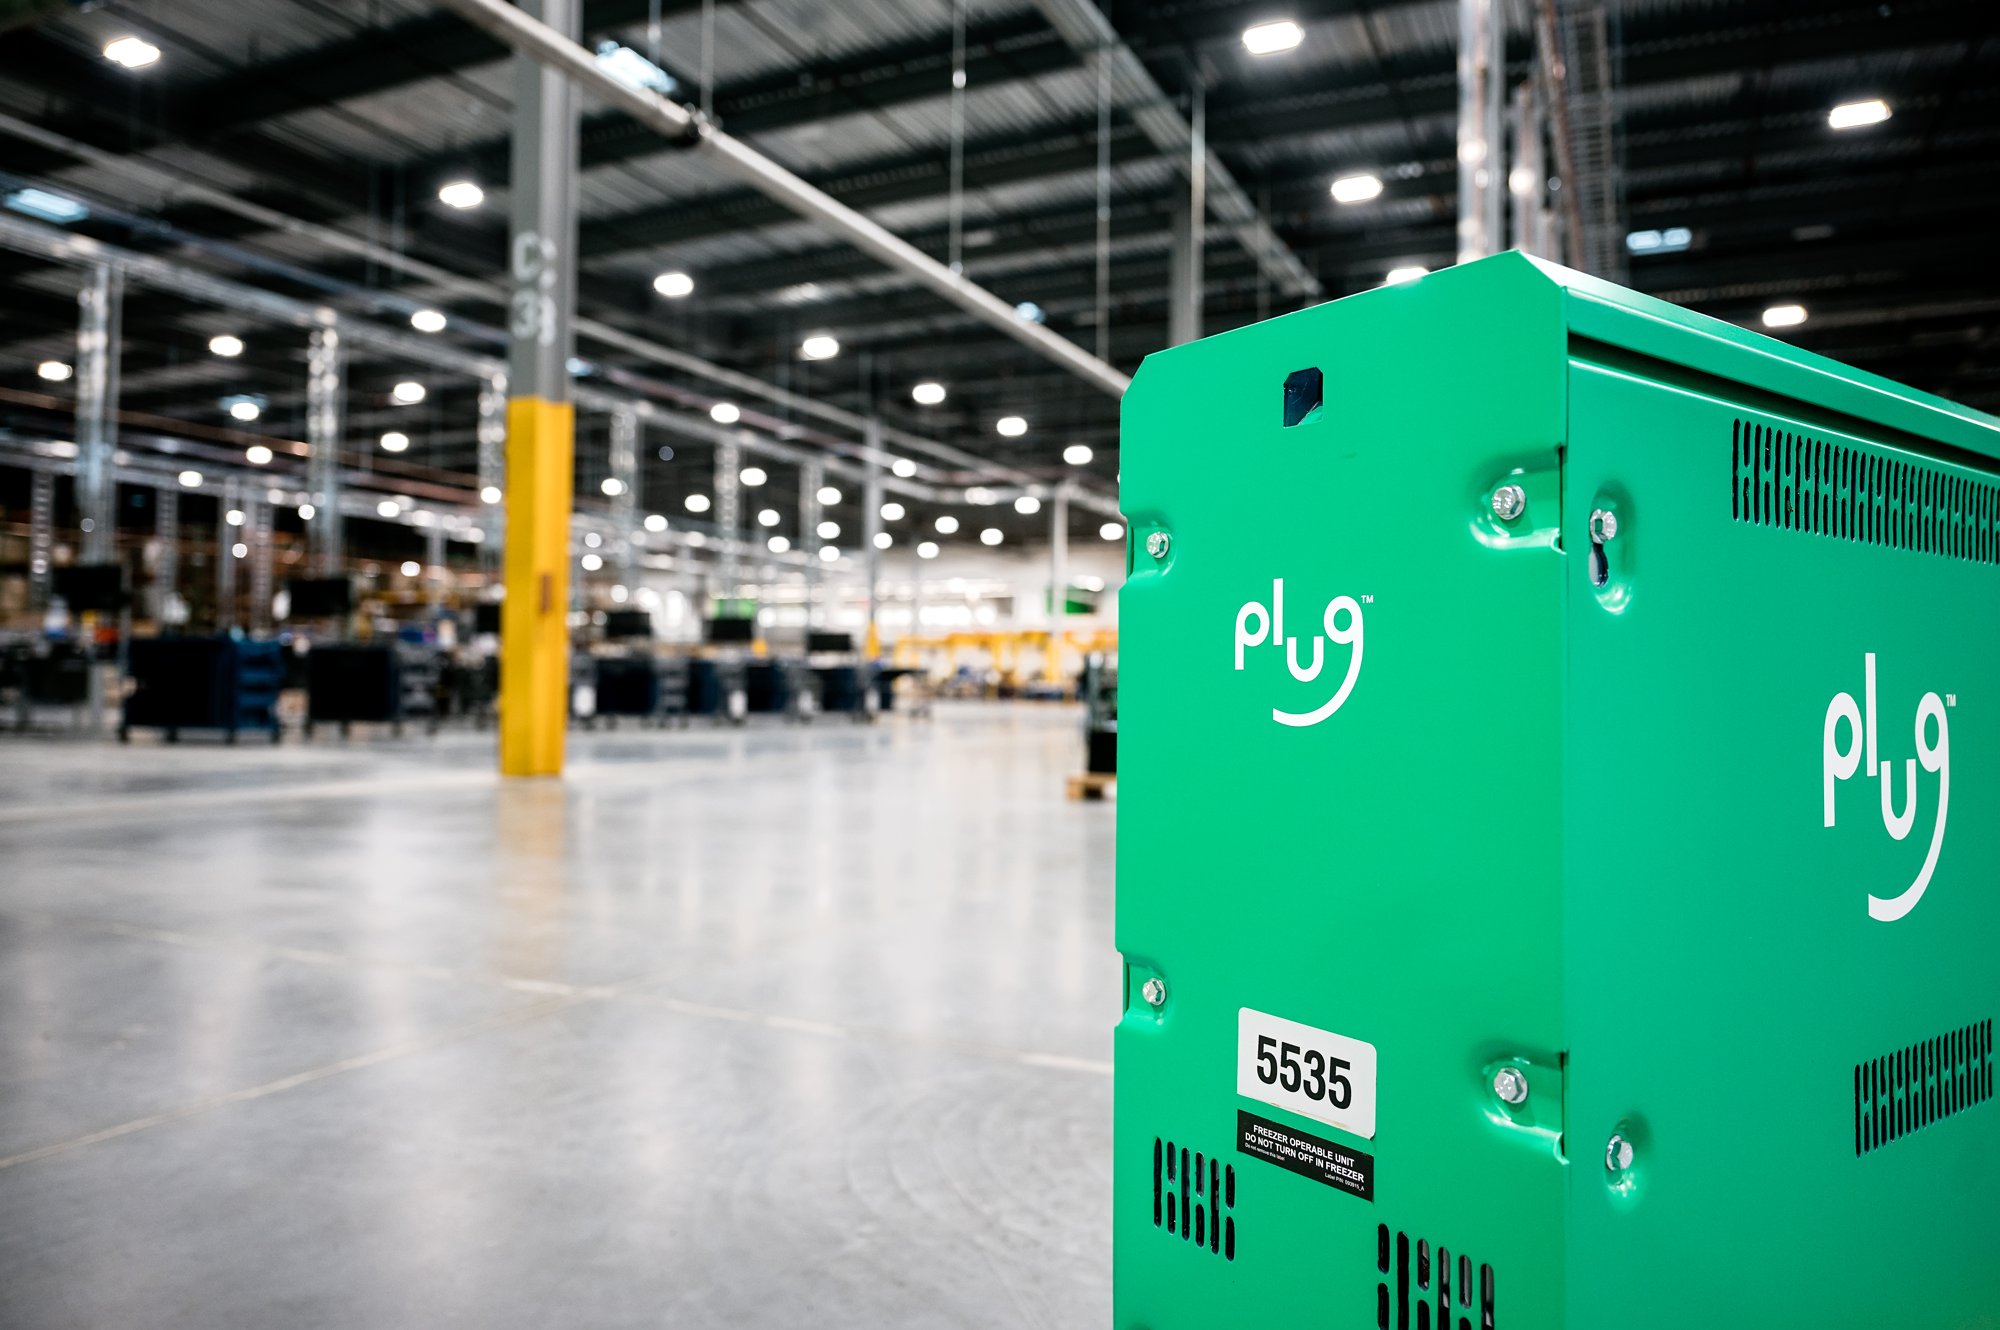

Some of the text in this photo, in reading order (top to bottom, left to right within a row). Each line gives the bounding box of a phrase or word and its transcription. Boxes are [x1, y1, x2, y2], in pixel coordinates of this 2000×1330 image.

[1234, 577, 1364, 727] plug
[1823, 652, 1949, 922] plug
[1256, 1034, 1352, 1110] 5535
[1245, 1132, 1365, 1183] DO NOT TURN OFF IN FREEZER
[1253, 1124, 1354, 1167] FREEZER OPERABLE UNIT
[1324, 1172, 1336, 1181] Label
